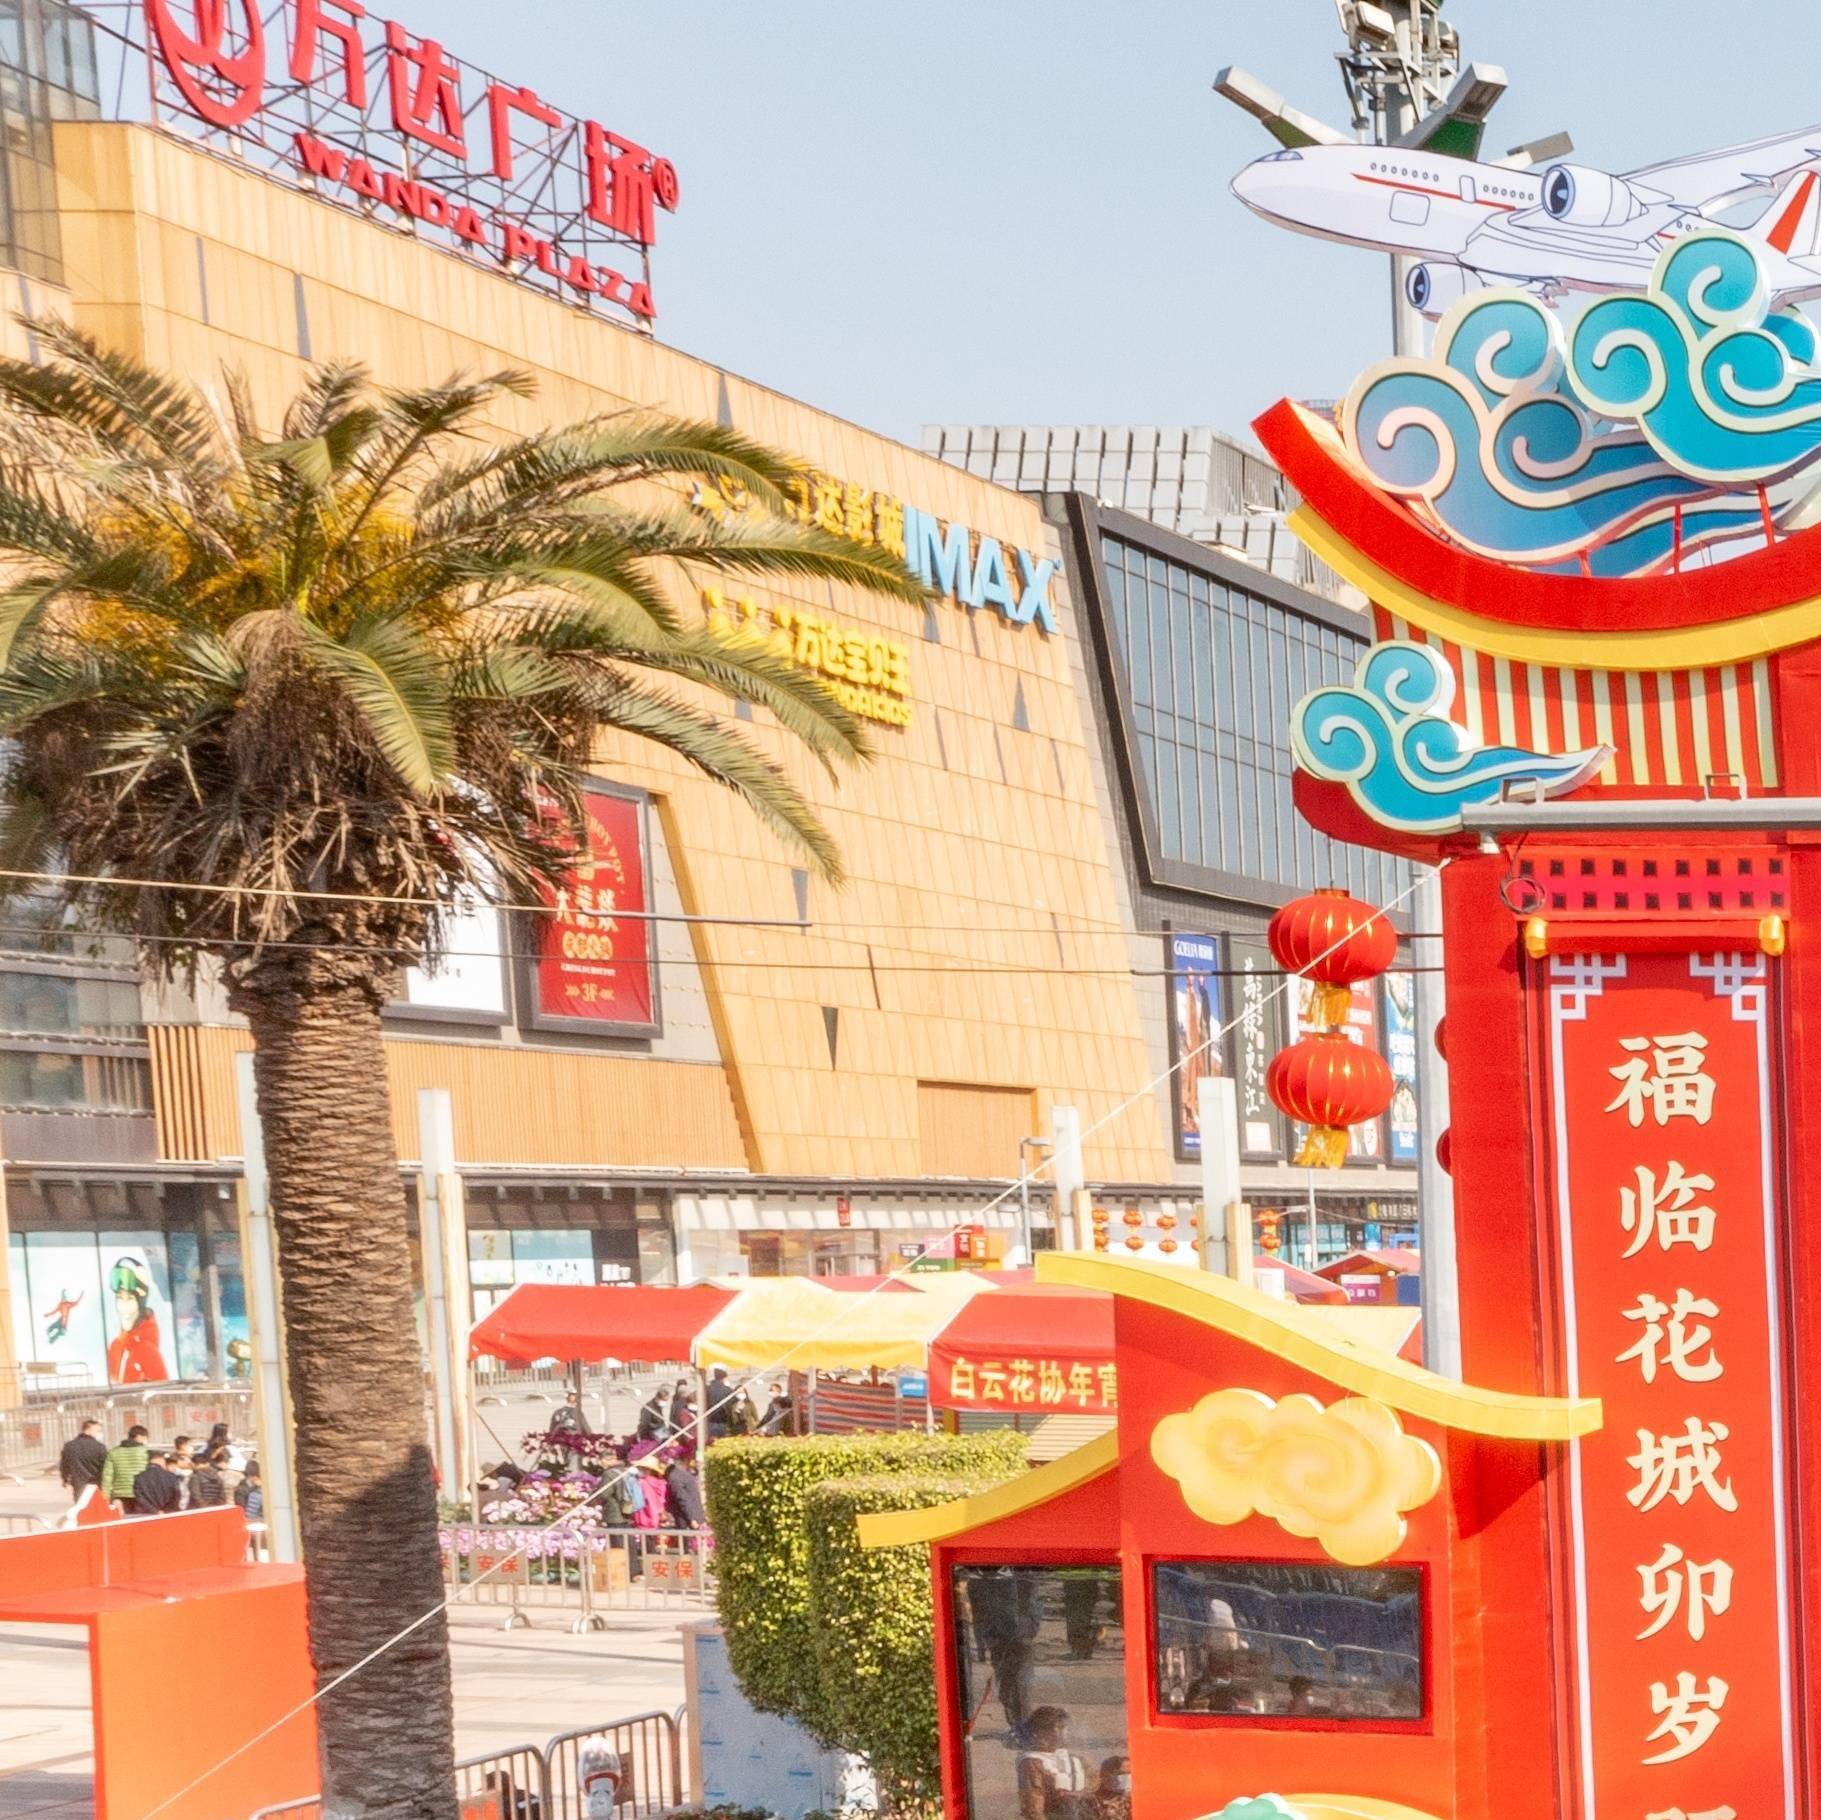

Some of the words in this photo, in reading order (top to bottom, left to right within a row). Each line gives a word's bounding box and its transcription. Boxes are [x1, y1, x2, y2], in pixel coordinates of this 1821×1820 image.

[288, 0, 656, 246] 万达广场
[294, 132, 486, 246] WANDA
[502, 222, 656, 319] PLAZA
[903, 504, 1056, 635] IMAX
[476, 1555, 519, 1574] 安保
[651, 1559, 696, 1580] 安保
